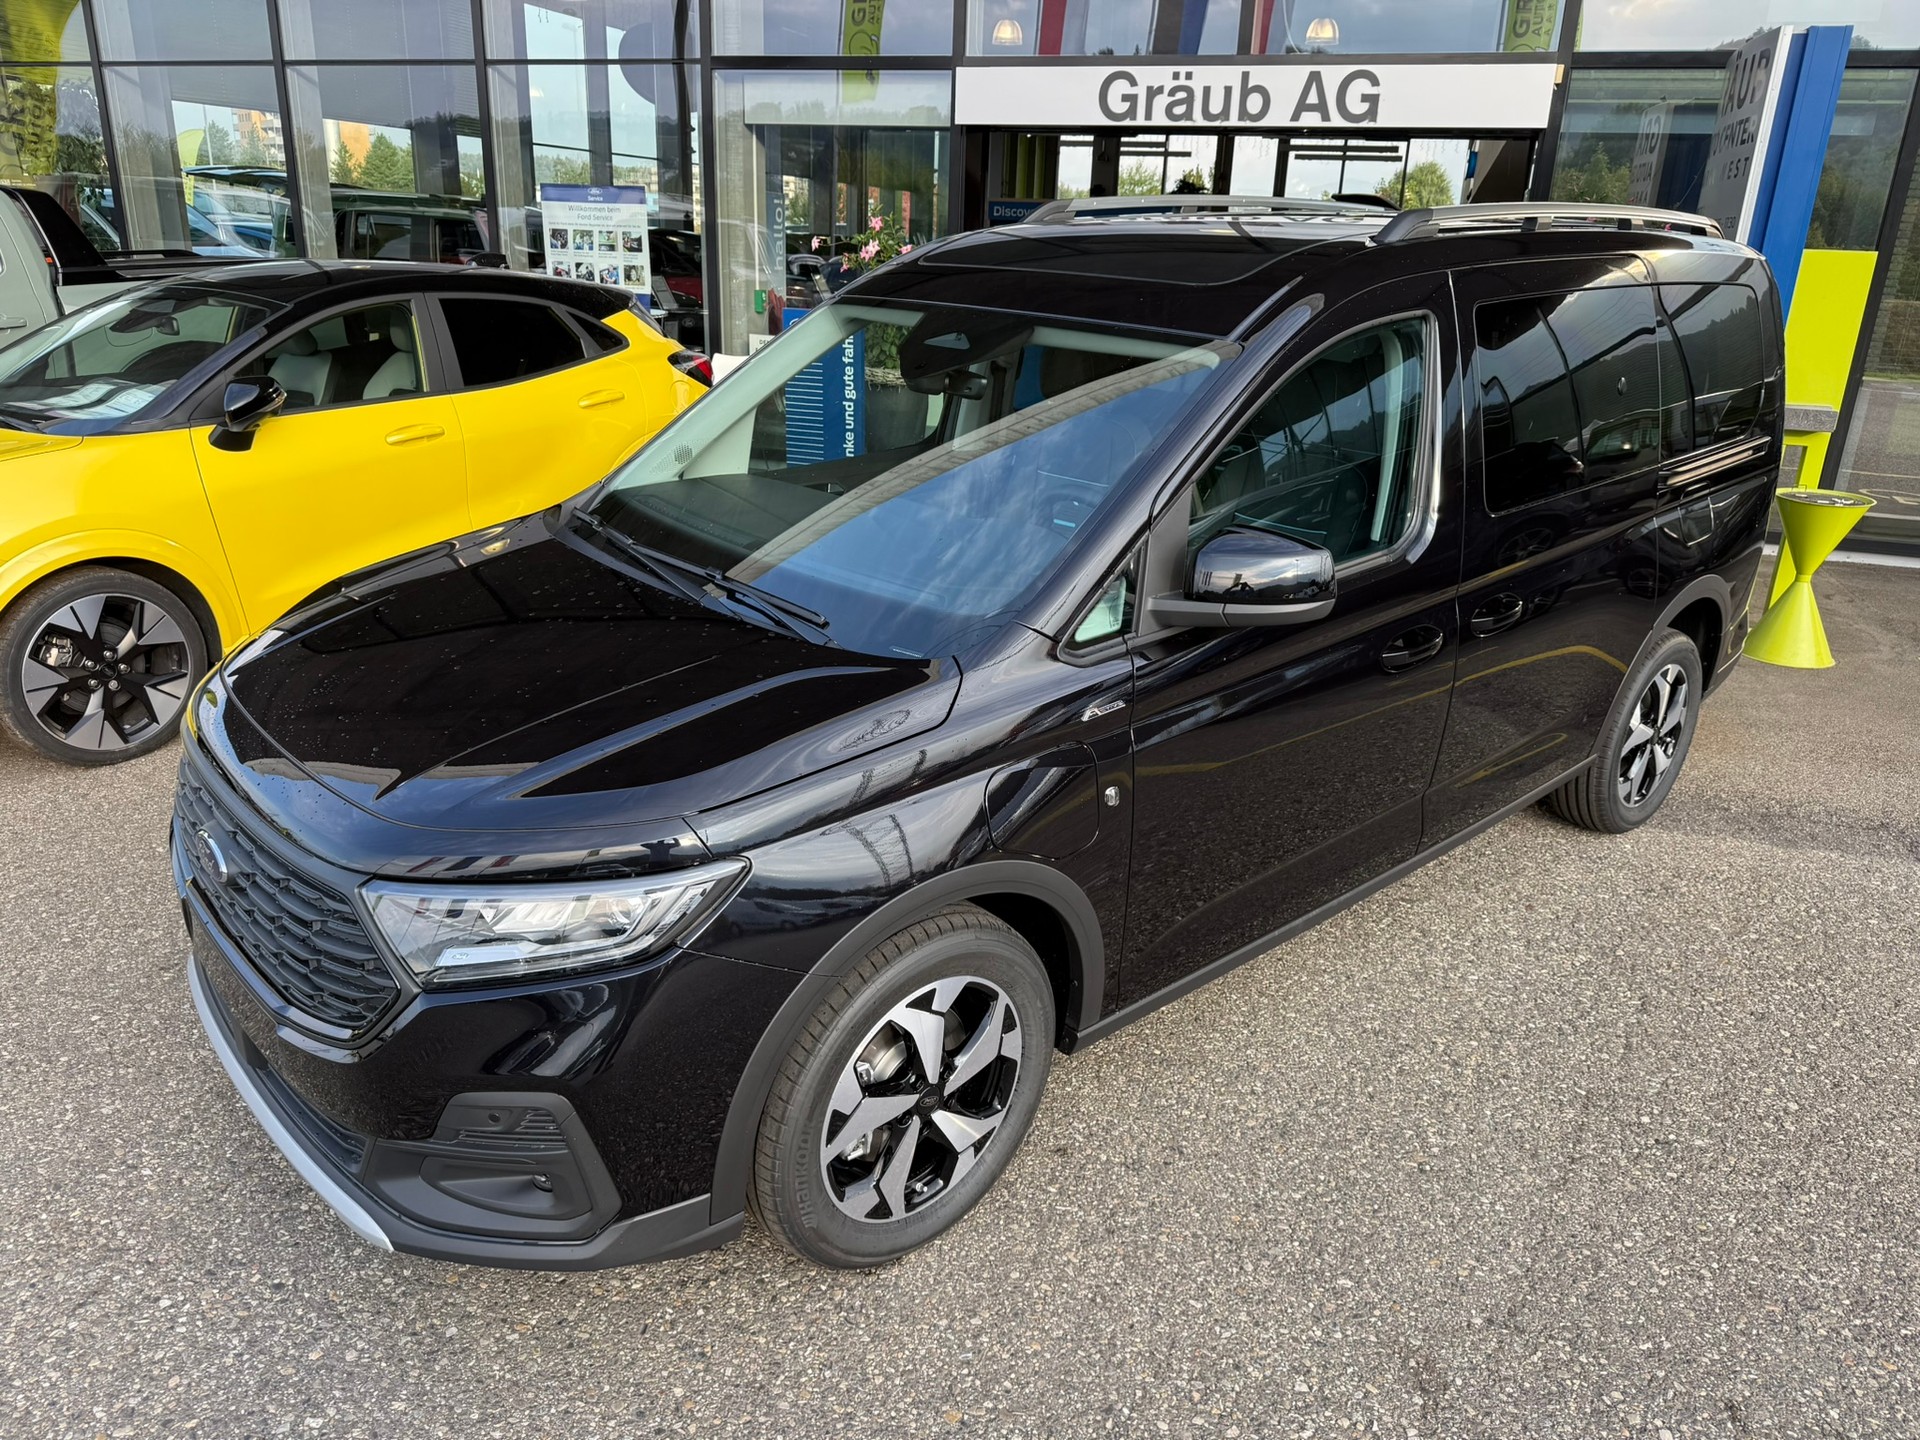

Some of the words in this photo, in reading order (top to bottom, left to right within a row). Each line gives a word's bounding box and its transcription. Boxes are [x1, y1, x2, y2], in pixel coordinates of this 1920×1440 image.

[1099, 70, 1271, 122] Gräub
[1289, 69, 1380, 124] AG
[607, 205, 621, 213] beim
[993, 205, 1034, 217] Discov
[773, 199, 784, 271] hallo!
[842, 365, 857, 399] gute
[842, 400, 855, 429] und
